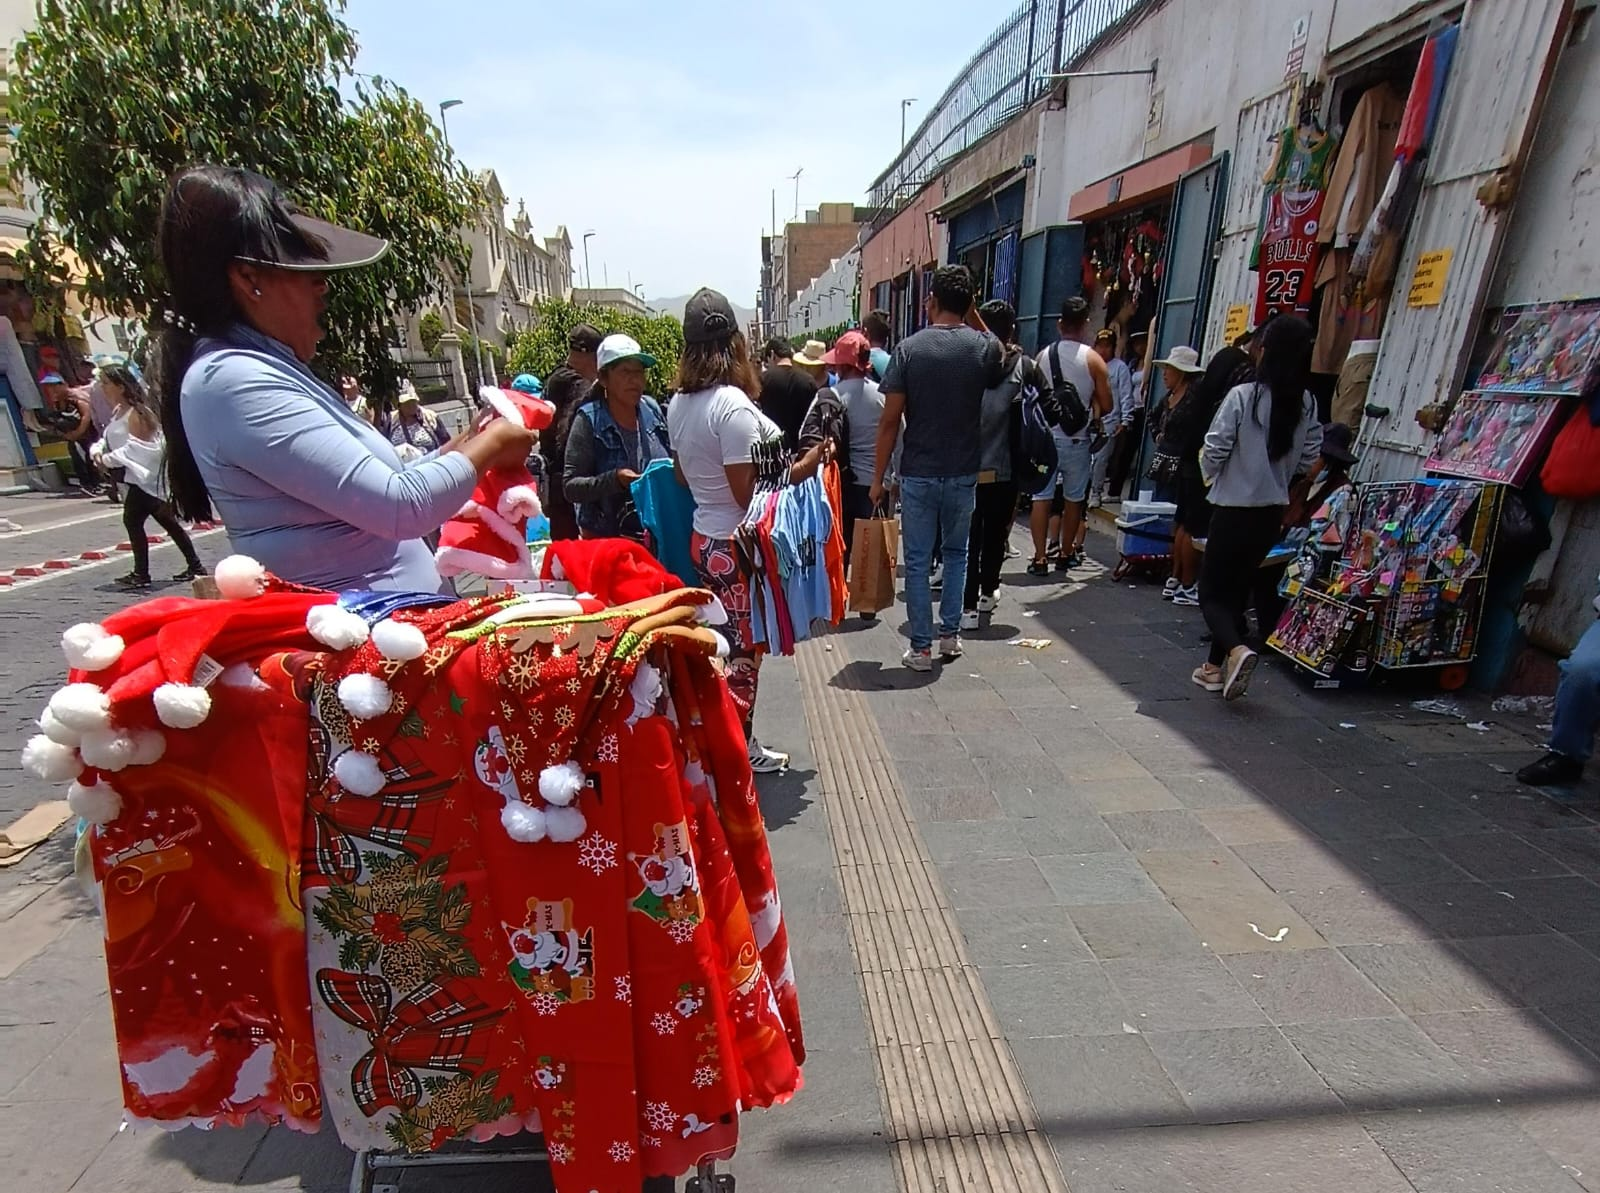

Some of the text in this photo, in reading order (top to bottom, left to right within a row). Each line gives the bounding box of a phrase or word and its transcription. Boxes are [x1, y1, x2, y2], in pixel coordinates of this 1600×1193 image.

[1266, 239, 1314, 265] BULLS
[1265, 268, 1305, 305] 23
[544, 904, 553, 930] X-MAS
